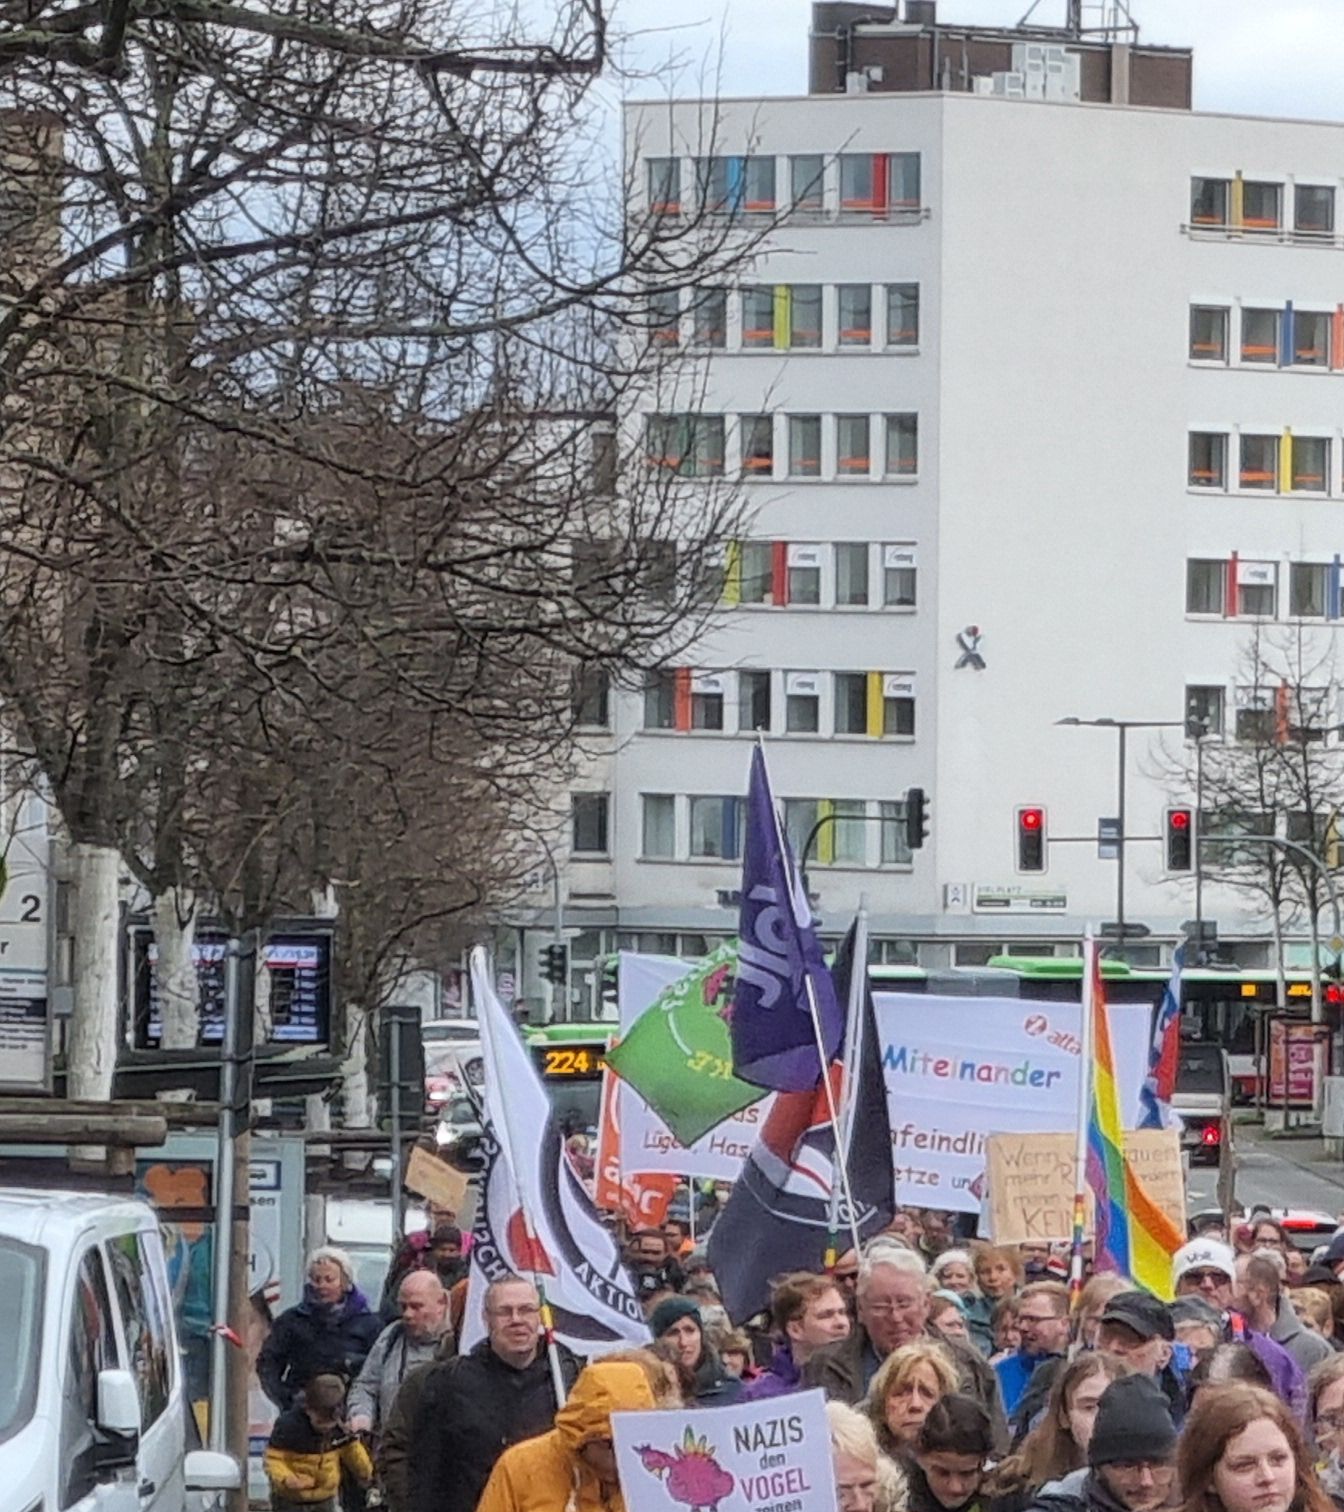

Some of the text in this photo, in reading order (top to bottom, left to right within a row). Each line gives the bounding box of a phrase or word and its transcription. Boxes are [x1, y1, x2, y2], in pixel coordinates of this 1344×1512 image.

[20, 894, 42, 923] 2
[1047, 1030, 1084, 1056] atta
[545, 1050, 589, 1074] 224
[882, 1043, 1061, 1089] Miteinander
[951, 1174, 983, 1190] un
[733, 1416, 804, 1452] NAZIS
[759, 1453, 786, 1471] den
[740, 1470, 812, 1503] VOGEL
